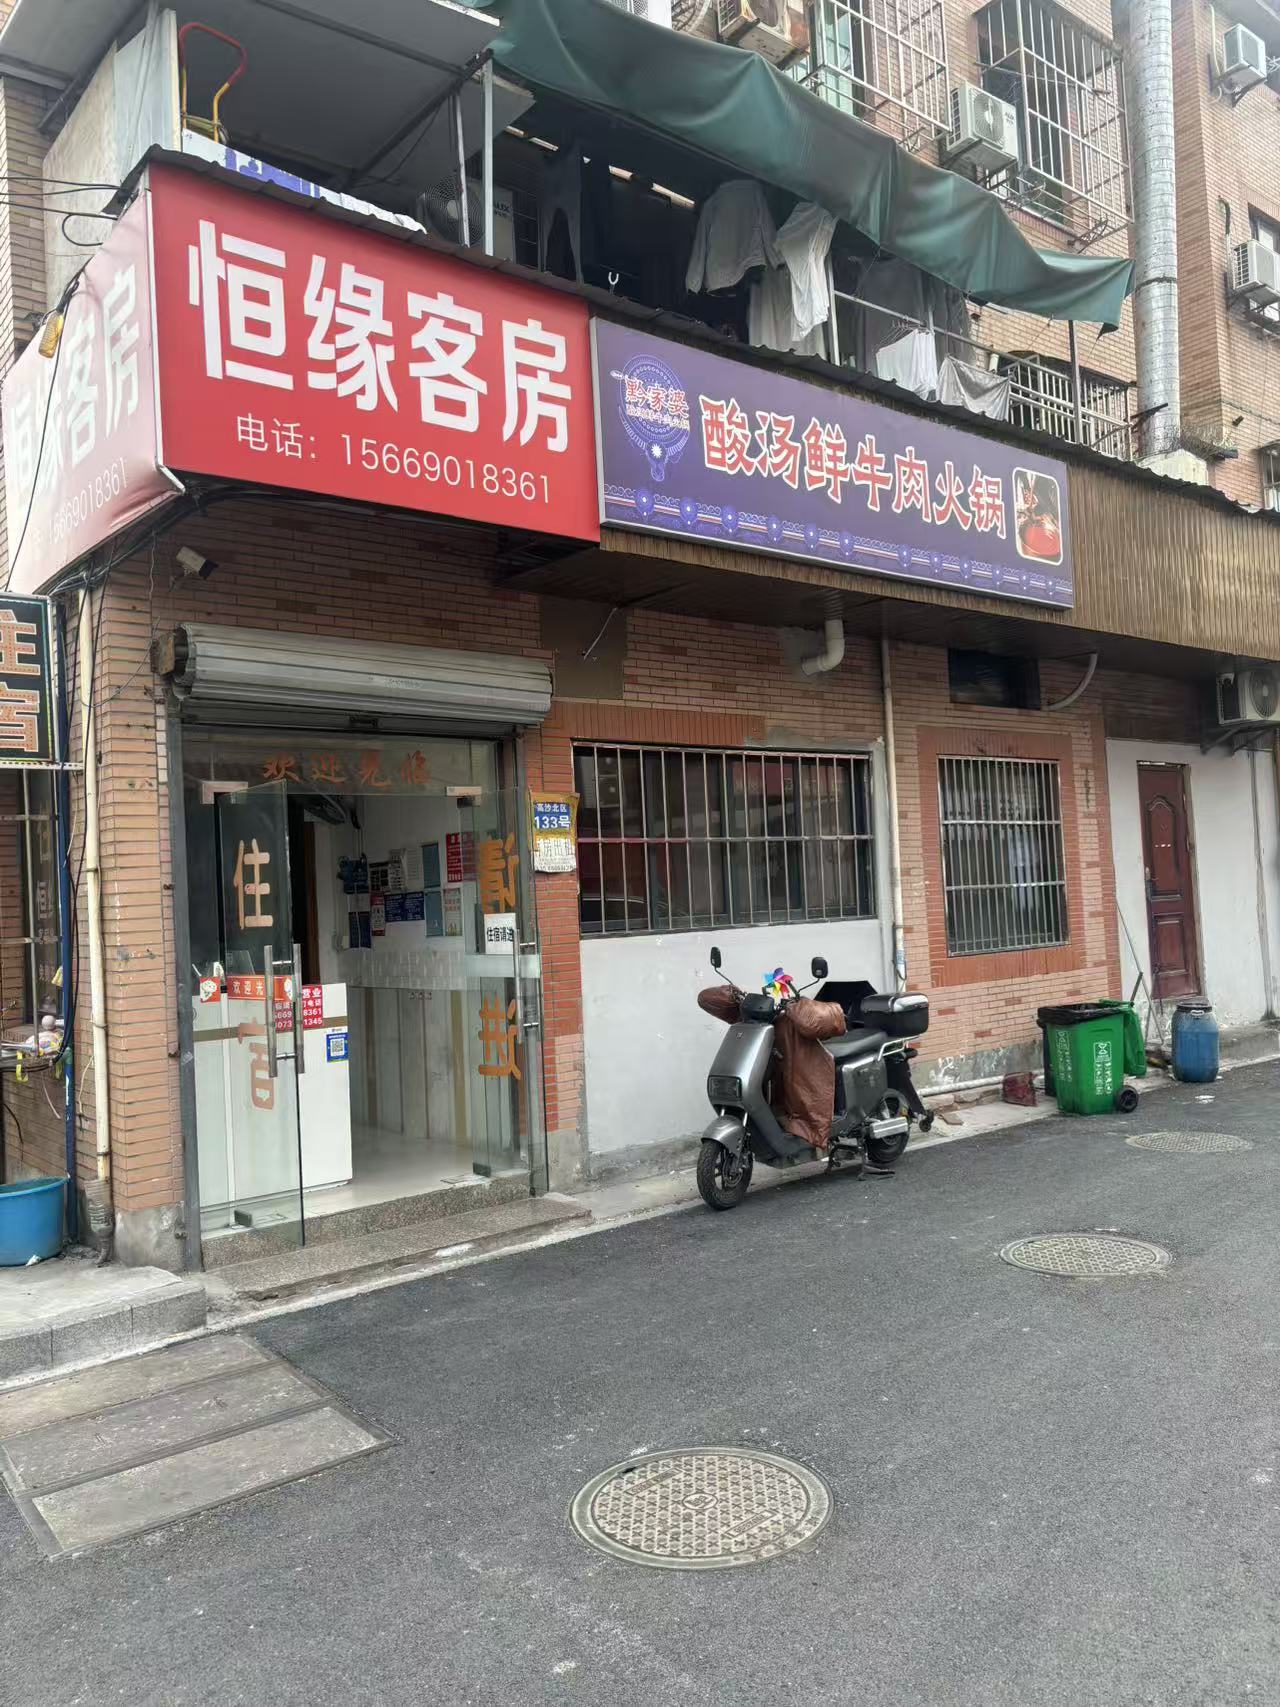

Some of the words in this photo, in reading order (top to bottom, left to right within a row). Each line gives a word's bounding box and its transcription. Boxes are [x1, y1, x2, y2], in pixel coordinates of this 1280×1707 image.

[188, 219, 572, 453] 恒缘客房
[624, 375, 690, 419] 黔家婆
[340, 434, 549, 503] 15669018361
[699, 395, 1006, 539] 酸汤鲜牛肉火锅
[263, 750, 432, 786] 欢迎光临
[534, 815, 571, 829] 133号
[536, 803, 568, 813] 高沙北区
[233, 981, 264, 995] 欢迎光
